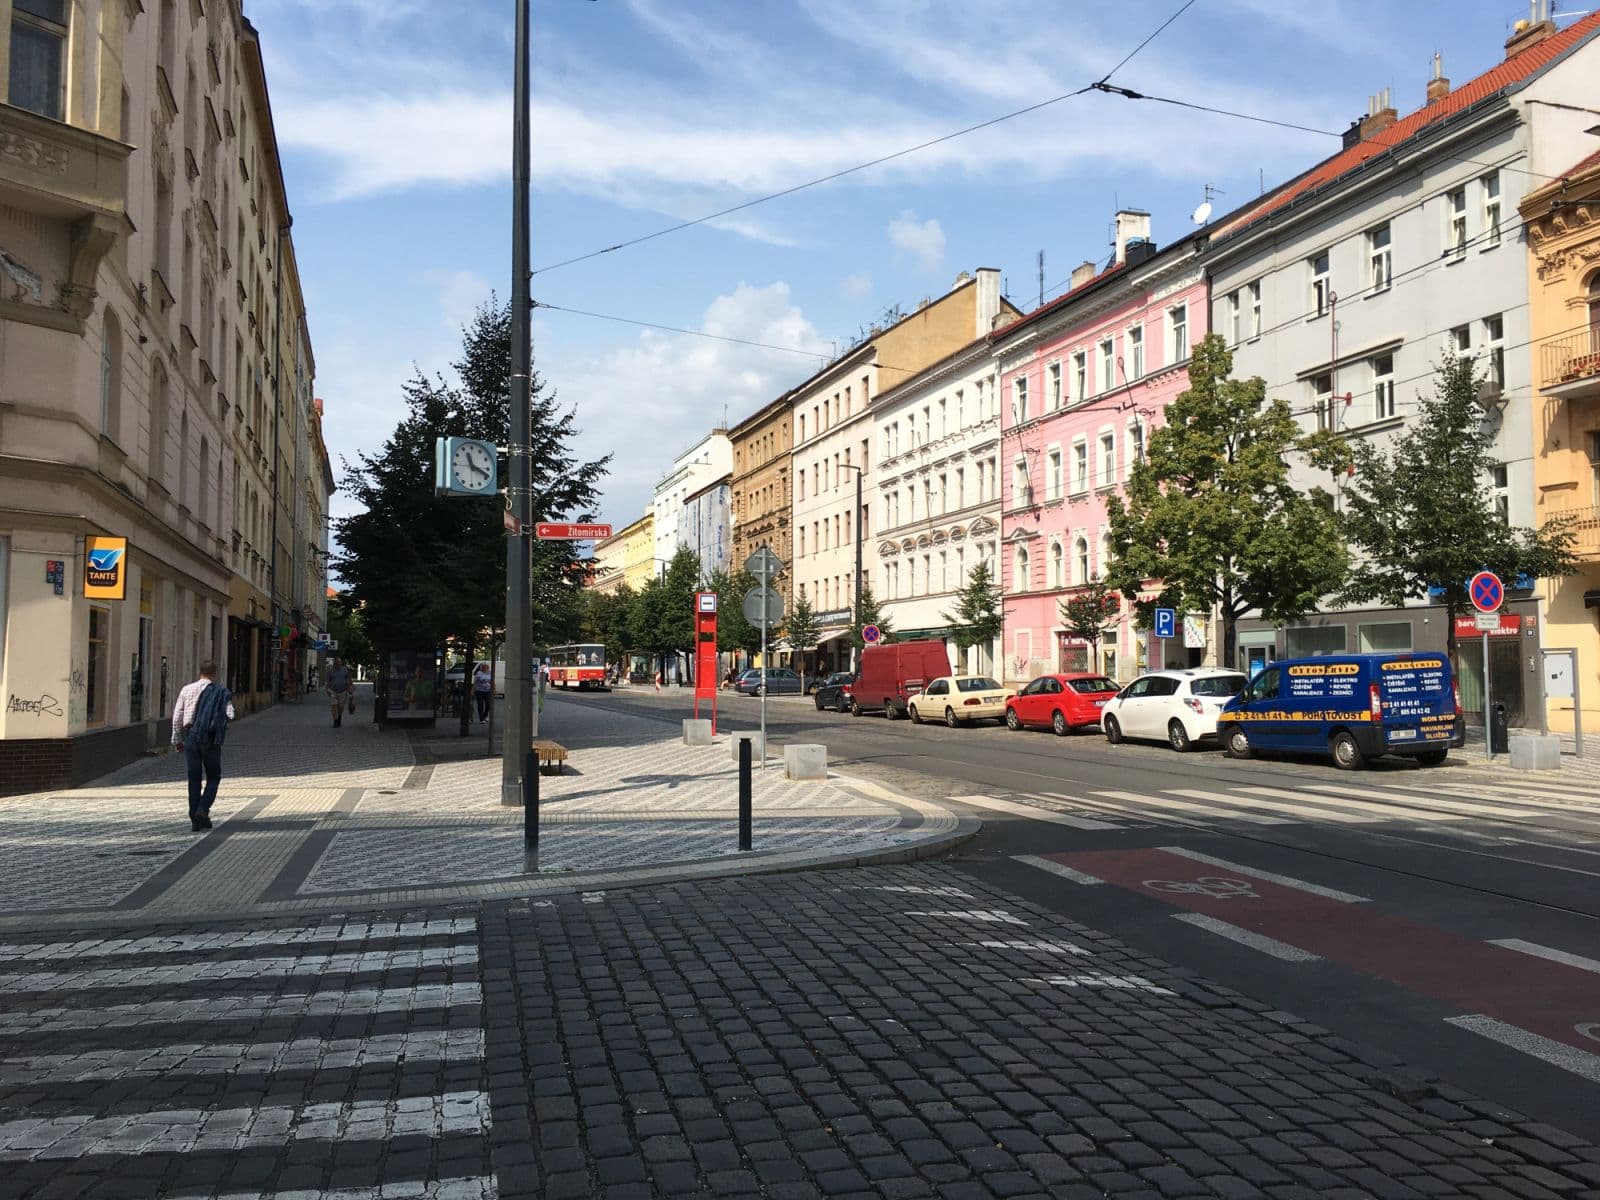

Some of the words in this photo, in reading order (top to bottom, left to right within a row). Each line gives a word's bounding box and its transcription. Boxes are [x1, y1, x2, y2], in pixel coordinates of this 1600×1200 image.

[88, 572, 117, 580] TANTE
[1159, 611, 1171, 629] P
[1302, 712, 1363, 720] POHOTOVOST
[1421, 715, 1437, 723] NON
[1438, 713, 1456, 721] STOP
